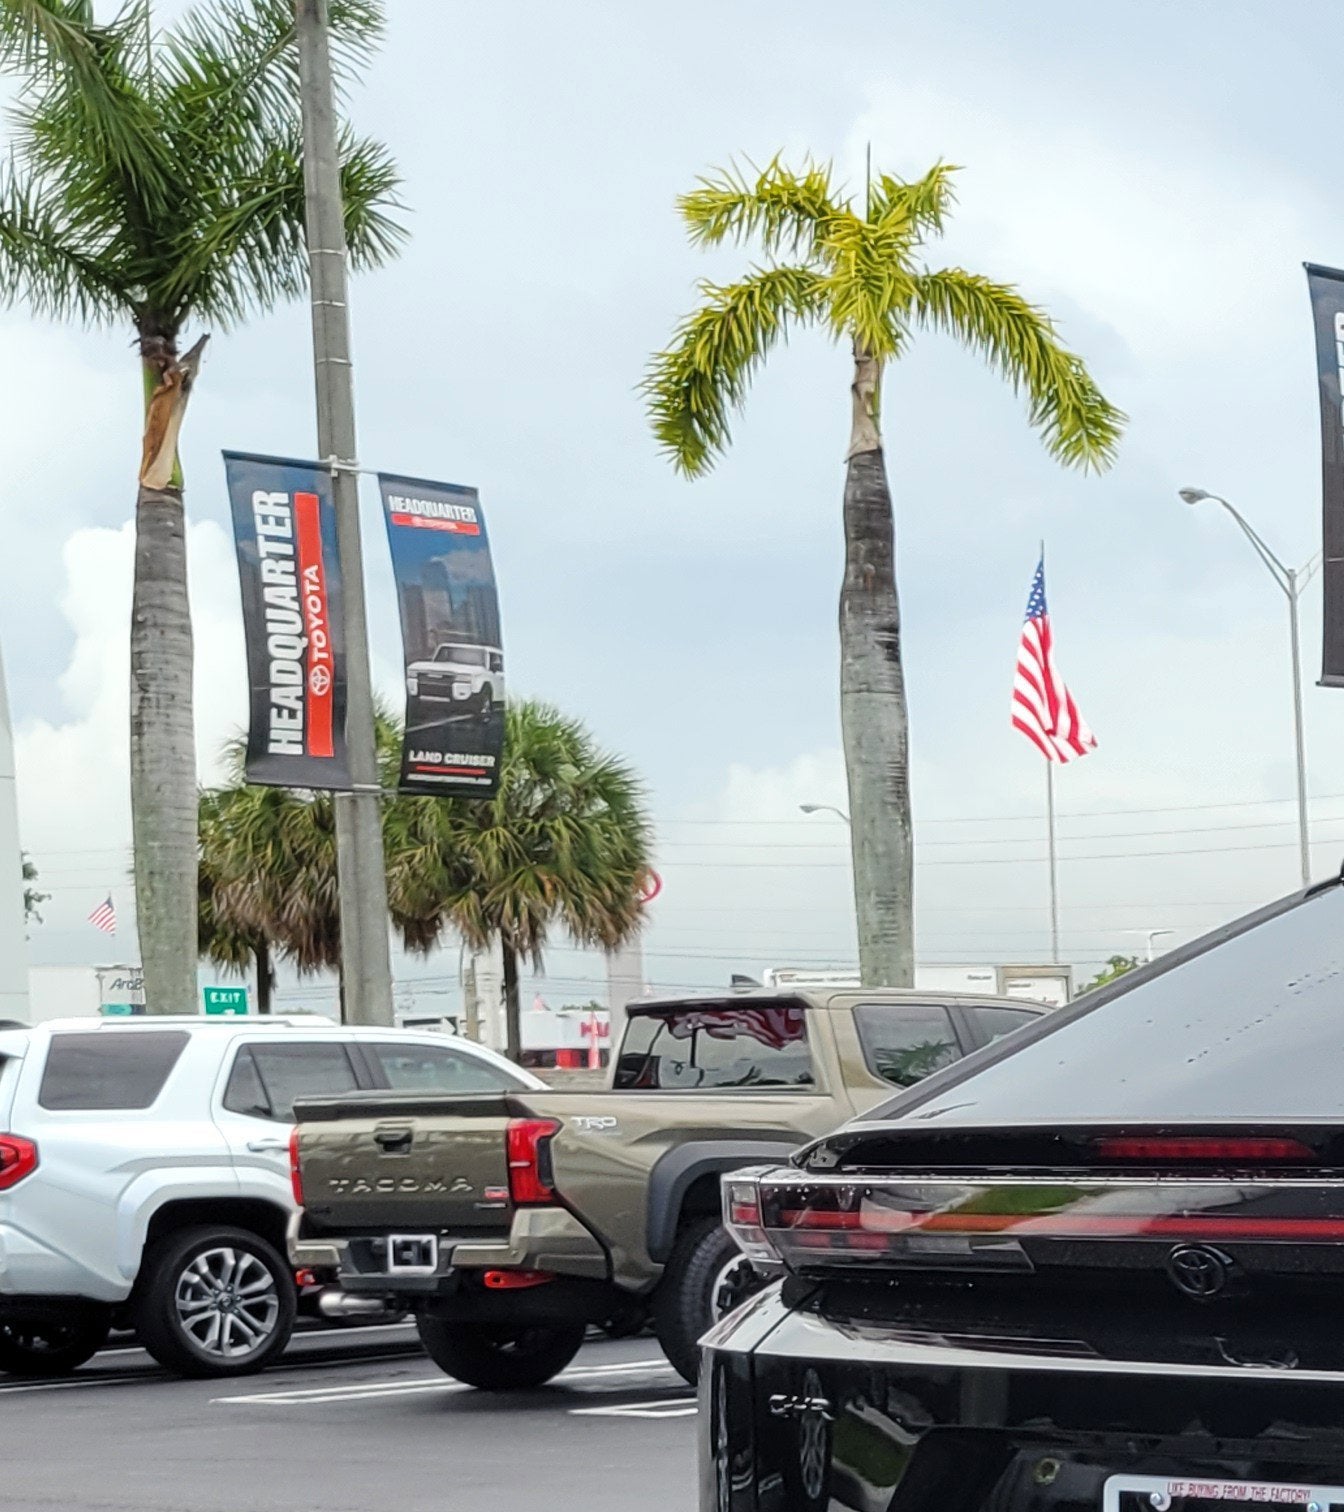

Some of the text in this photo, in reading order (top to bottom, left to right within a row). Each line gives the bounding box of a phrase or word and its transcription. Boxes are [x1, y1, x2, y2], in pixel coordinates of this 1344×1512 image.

[388, 495, 478, 522] HEADQUARTER
[303, 564, 327, 662] TOYOTA
[252, 490, 308, 755] HEADQUARTER
[409, 750, 496, 767] LAND CRUISER
[210, 992, 241, 1003] EXIT
[571, 1116, 617, 1130] TRD
[328, 1177, 474, 1193] TACOMA
[1167, 1482, 1184, 1494] LIKE
[1188, 1483, 1219, 1496] BUYING
[1223, 1484, 1247, 1497] FROM
[1250, 1486, 1267, 1498] THE
